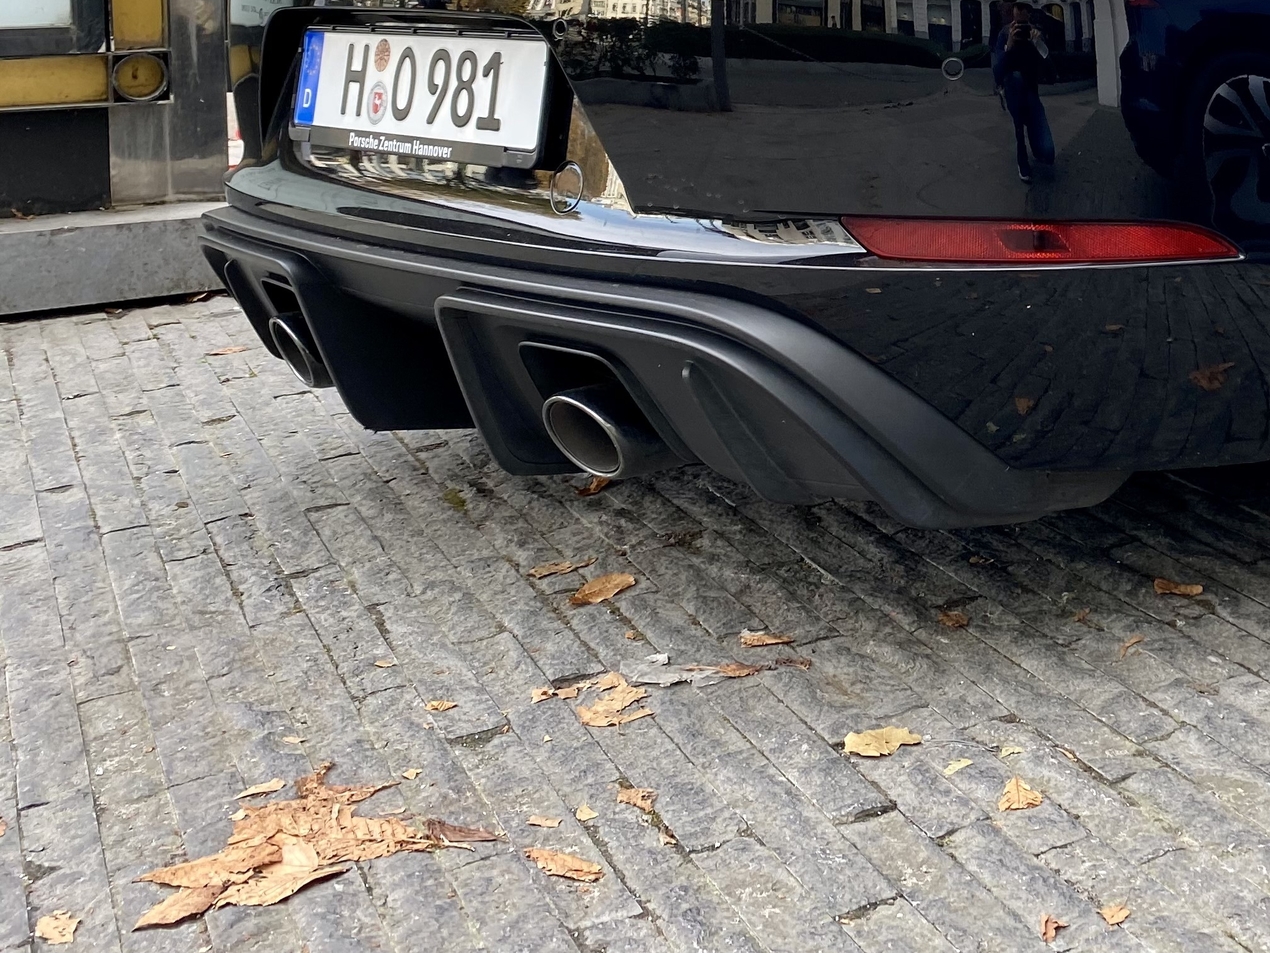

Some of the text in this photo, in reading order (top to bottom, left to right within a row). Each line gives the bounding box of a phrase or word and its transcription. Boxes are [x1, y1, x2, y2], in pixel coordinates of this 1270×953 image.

[302, 88, 313, 108] D
[340, 43, 371, 117] H
[426, 48, 502, 132] 981
[348, 132, 453, 158] Porsche Zentrum Hannover
